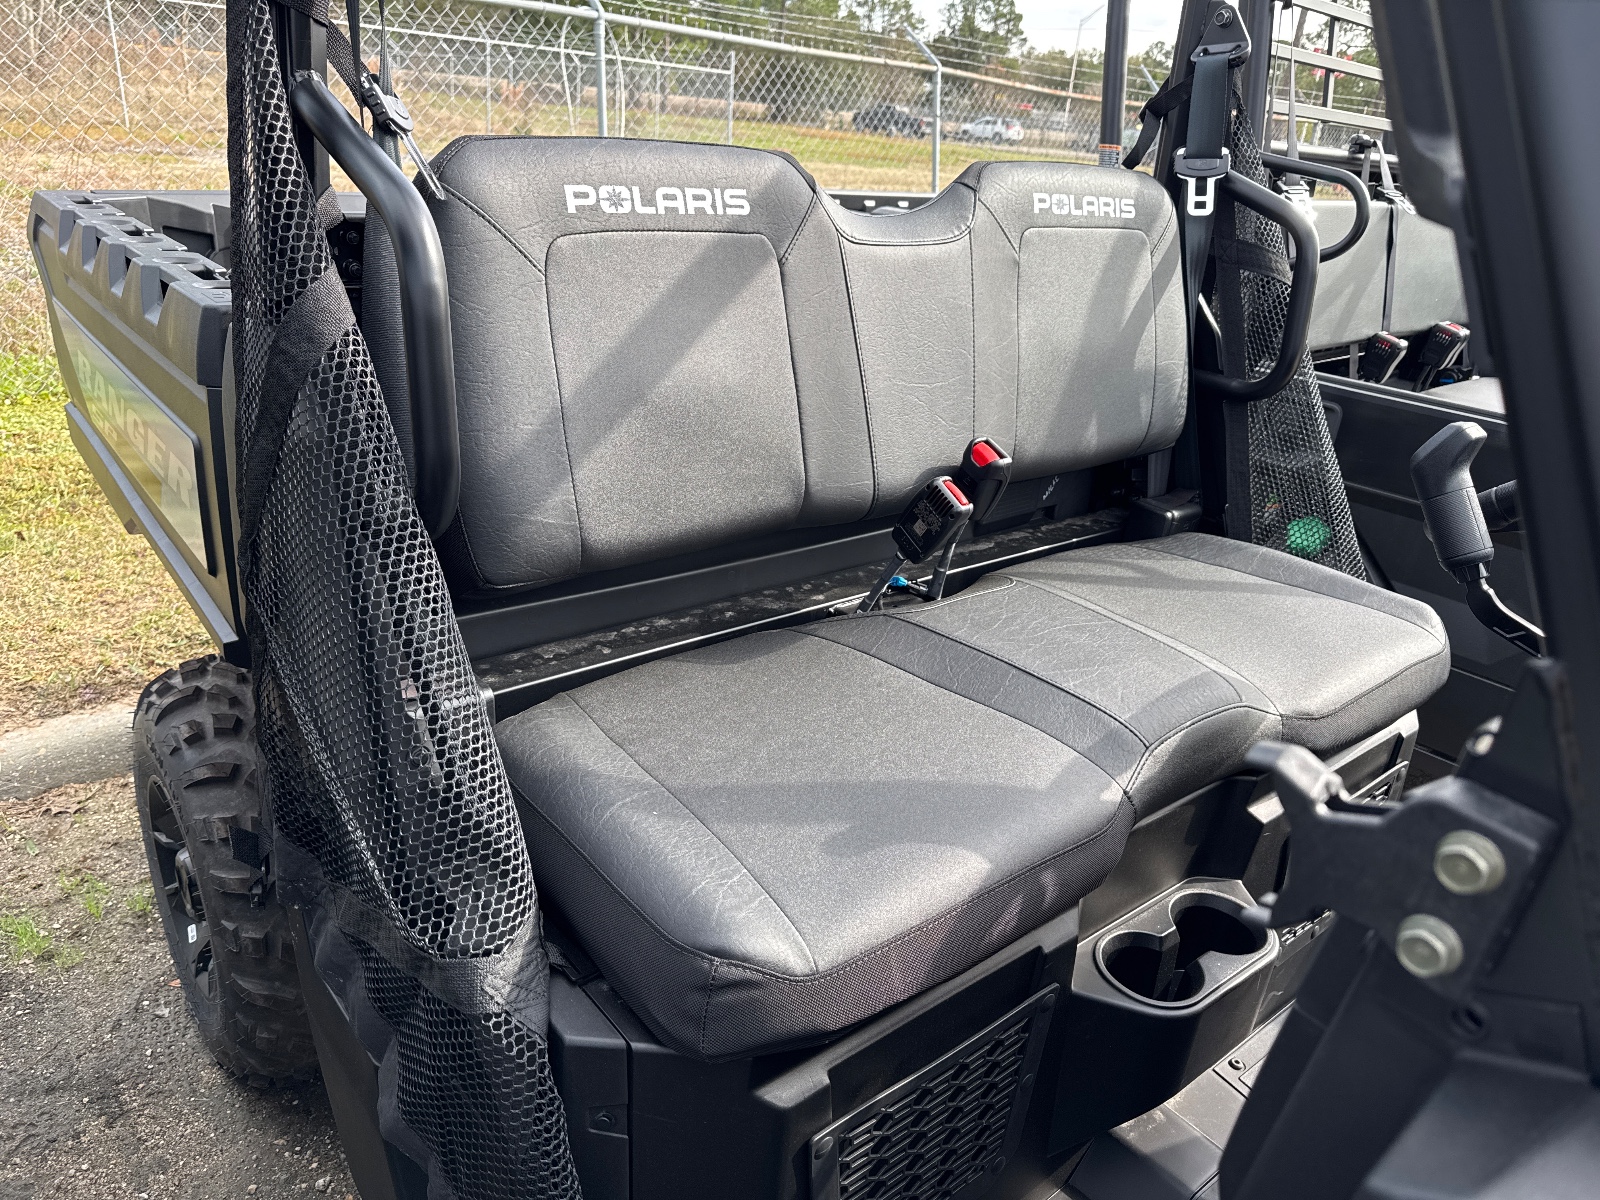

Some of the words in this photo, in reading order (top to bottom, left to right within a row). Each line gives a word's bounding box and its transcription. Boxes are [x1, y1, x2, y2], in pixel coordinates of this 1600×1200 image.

[564, 184, 750, 215] POLARIS
[1033, 192, 1136, 218] POLARIS
[77, 350, 192, 509] RANGER
